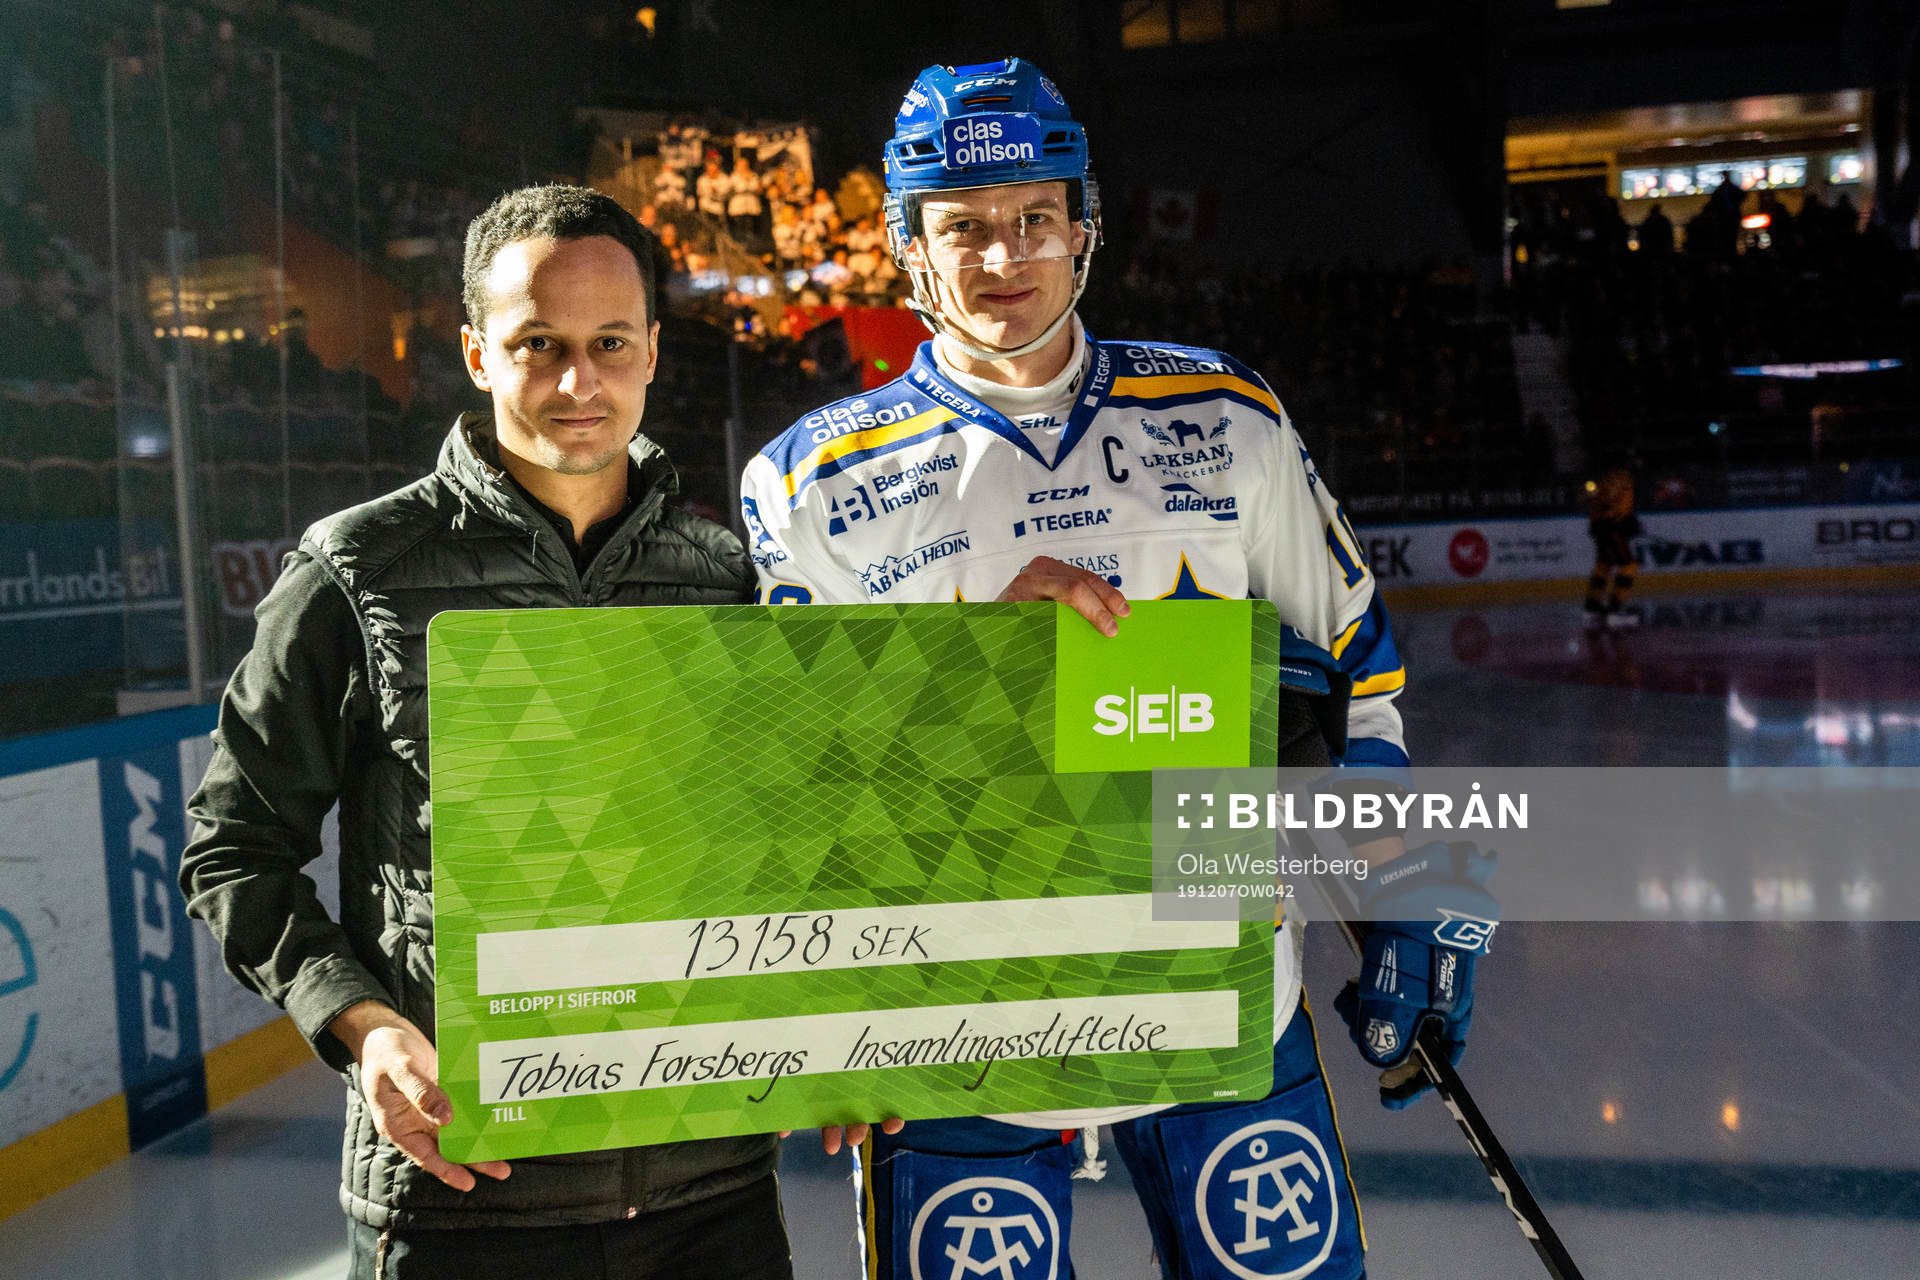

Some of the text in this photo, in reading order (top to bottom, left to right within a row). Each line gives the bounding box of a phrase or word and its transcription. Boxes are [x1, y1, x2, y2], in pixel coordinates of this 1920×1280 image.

[953, 78, 1017, 93] CCM
[953, 119, 1003, 142] clas
[955, 140, 1034, 165] ohlson
[1090, 347, 1110, 391] TEGERA
[1134, 358, 1234, 376] ohlson
[804, 398, 869, 430] clas
[811, 401, 917, 444] ohlson
[1020, 416, 1062, 429] SHL
[1102, 435, 1129, 483] C
[1140, 444, 1233, 468] LEKSAN
[872, 453, 958, 494] Bergkvist
[880, 480, 939, 515] Insjön
[1027, 485, 1090, 504] CCM
[1165, 495, 1237, 512] dalakra
[1816, 518, 1920, 544] BRO
[869, 574, 892, 597] AB
[922, 536, 971, 566] HEDIN
[1370, 537, 1412, 578] EK
[1279, 666, 1312, 677] LEKSAN
[1380, 864, 1421, 886] LEKSANDS
[124, 761, 181, 1064] CCM
[852, 925, 932, 960] SEK
[489, 989, 637, 1015] BELOPP I SIFFROR
[500, 1052, 623, 1099] Tobias
[639, 1040, 808, 1103] Forsbergs
[492, 1107, 526, 1123] TILL
